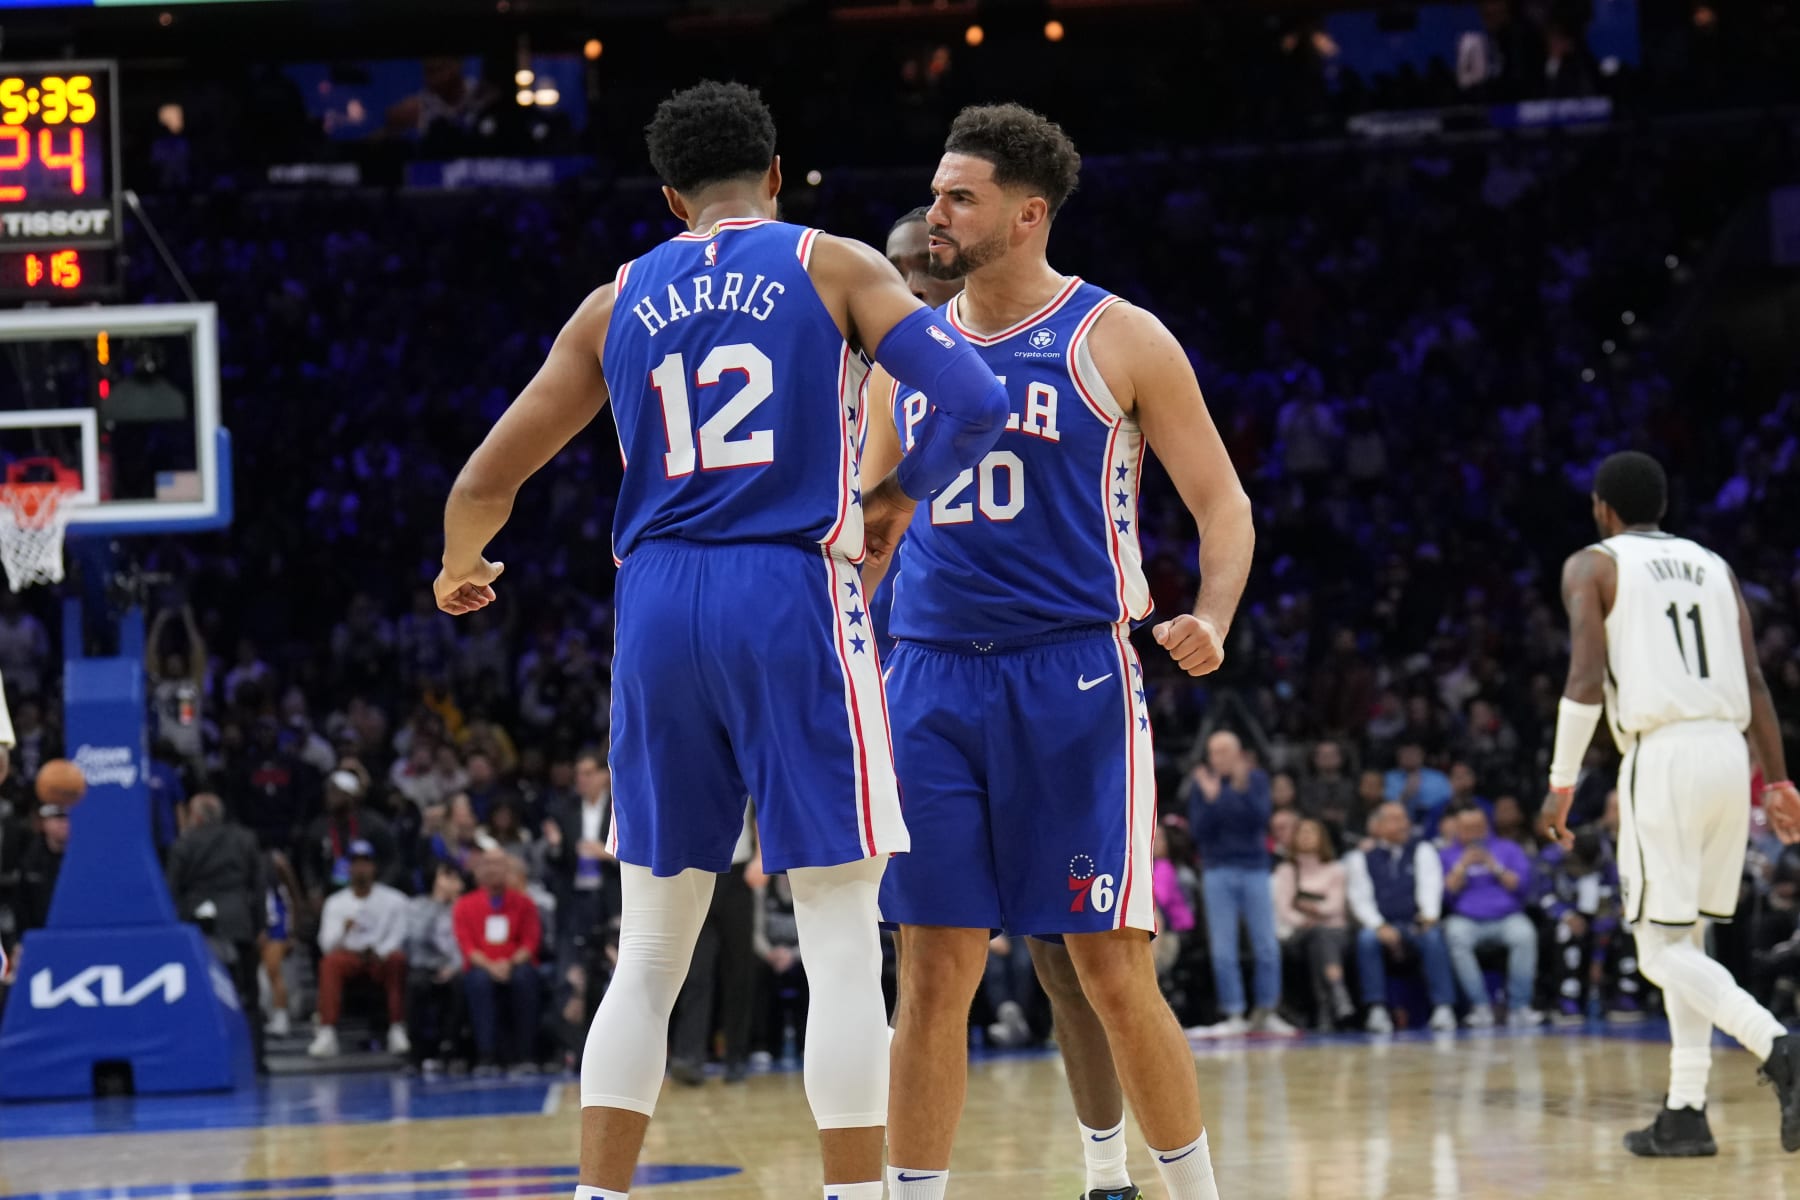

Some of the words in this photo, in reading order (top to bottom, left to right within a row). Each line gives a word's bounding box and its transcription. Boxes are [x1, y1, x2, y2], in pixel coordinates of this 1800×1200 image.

[0, 76, 96, 125] 5:35
[0, 125, 85, 202] 24
[4, 209, 111, 237] TISSOT
[26, 250, 81, 288] 1:15
[632, 271, 786, 337] HARRIS
[1014, 351, 1061, 359] crypto.com
[649, 342, 775, 480] 12
[930, 450, 1026, 527] 20
[1664, 600, 1711, 680] 11
[1068, 872, 1115, 913] 76
[29, 961, 187, 1010] KIA
